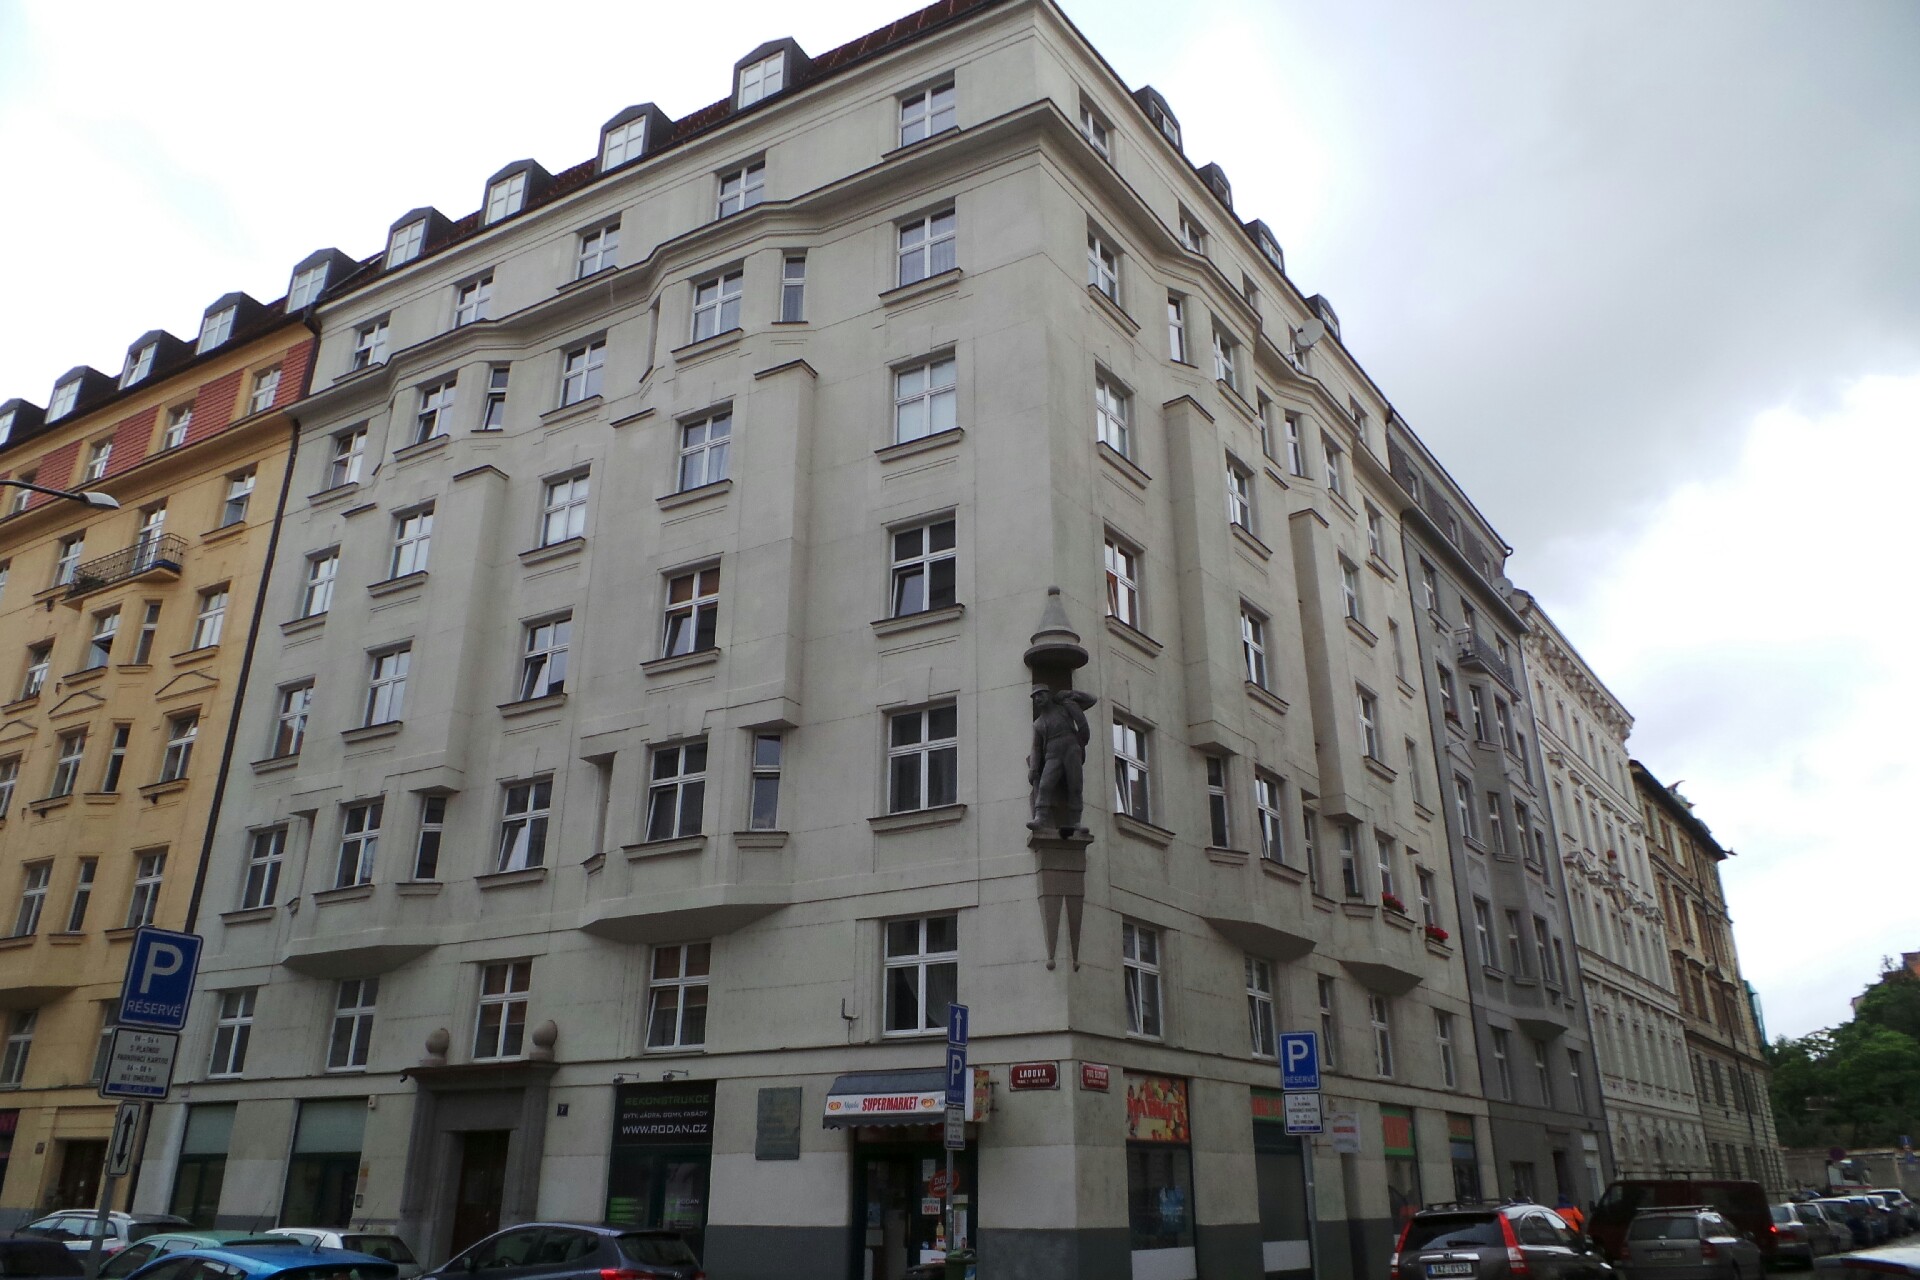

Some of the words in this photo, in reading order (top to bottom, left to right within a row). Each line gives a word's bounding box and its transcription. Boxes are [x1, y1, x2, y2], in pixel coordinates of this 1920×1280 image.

[139, 941, 183, 994] P
[127, 999, 182, 1018] RÉSERVÉ
[1287, 1039, 1309, 1072] P
[950, 1054, 962, 1086] P
[1019, 1068, 1046, 1078] LADOVA
[624, 1094, 710, 1106] REKONSTRUKCE
[861, 1096, 919, 1112] SUPERMARKET
[622, 1124, 708, 1135] WWW.RODAN.CZ
